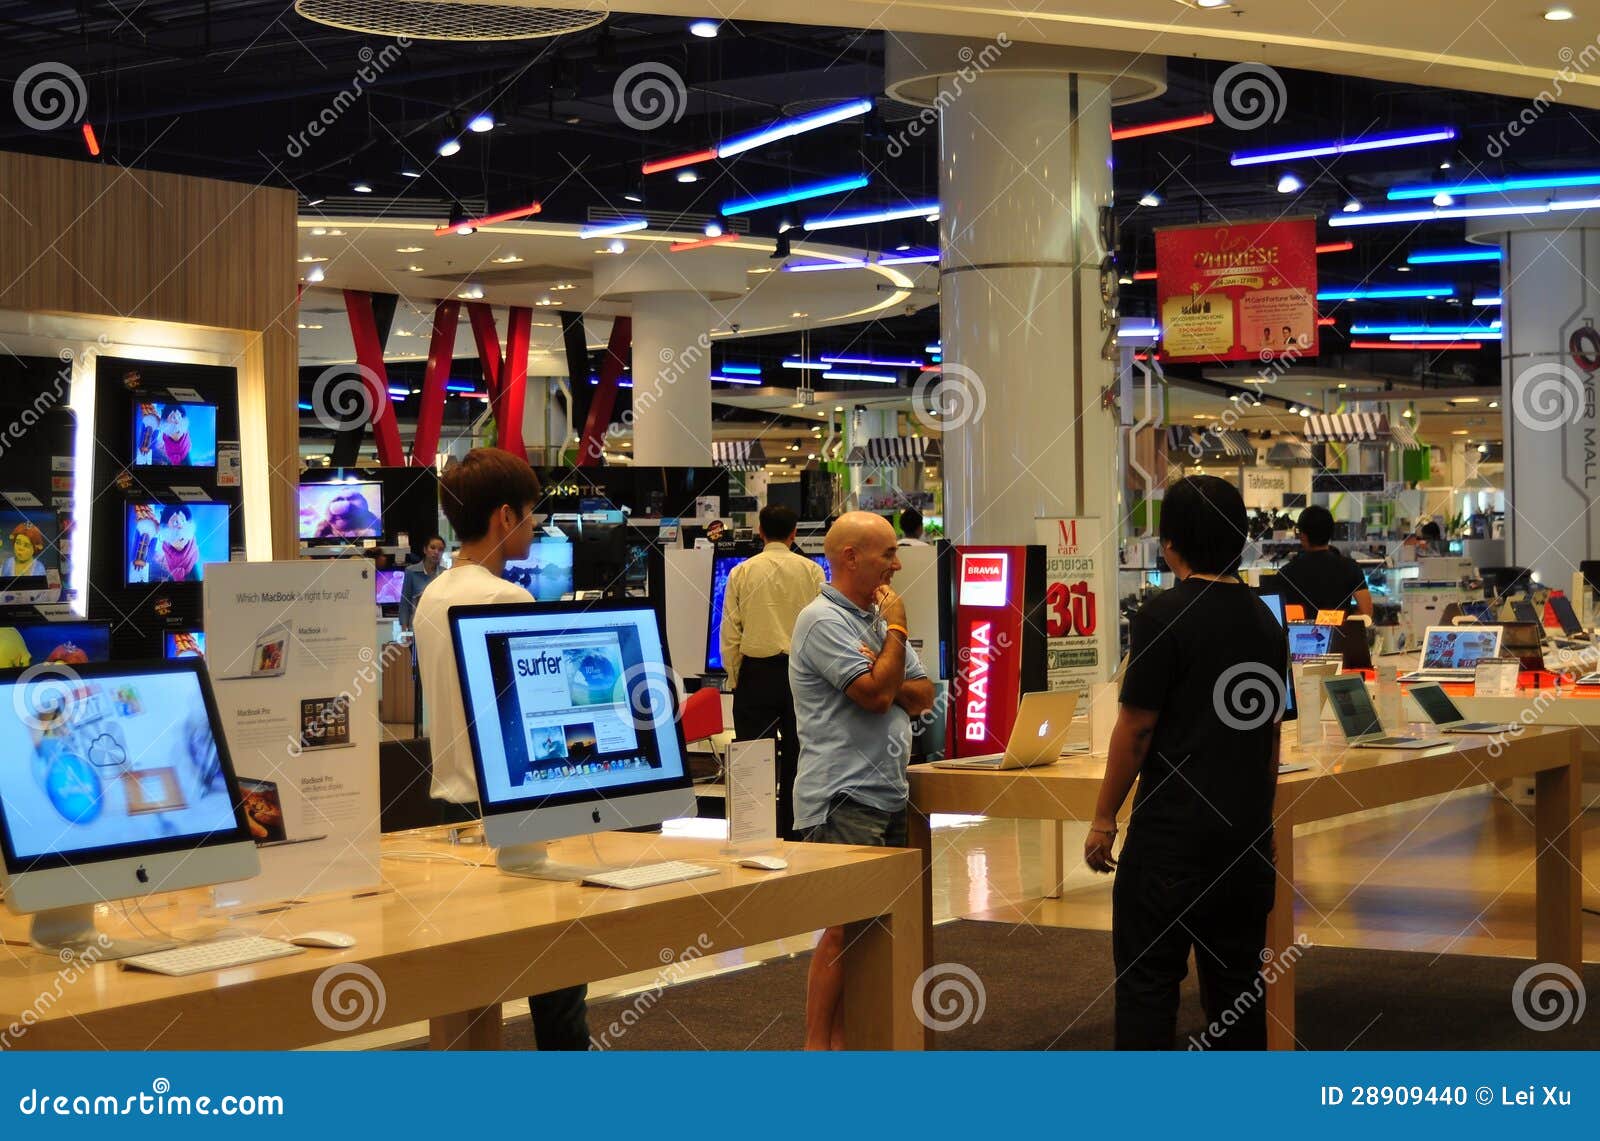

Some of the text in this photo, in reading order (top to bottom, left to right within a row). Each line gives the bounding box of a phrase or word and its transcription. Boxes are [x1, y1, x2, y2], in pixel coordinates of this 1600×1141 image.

[1194, 246, 1279, 268] CHINESE
[1583, 428, 1597, 489] MALL
[1058, 519, 1077, 546] M
[1058, 546, 1079, 555] care
[968, 566, 1000, 575] BRAVIA
[235, 592, 259, 603] Which
[261, 591, 296, 602] MacBook
[304, 590, 321, 603] right
[322, 589, 332, 600] for
[334, 589, 350, 602] you?
[517, 650, 562, 677] surfer
[966, 622, 991, 741] BRAVIA
